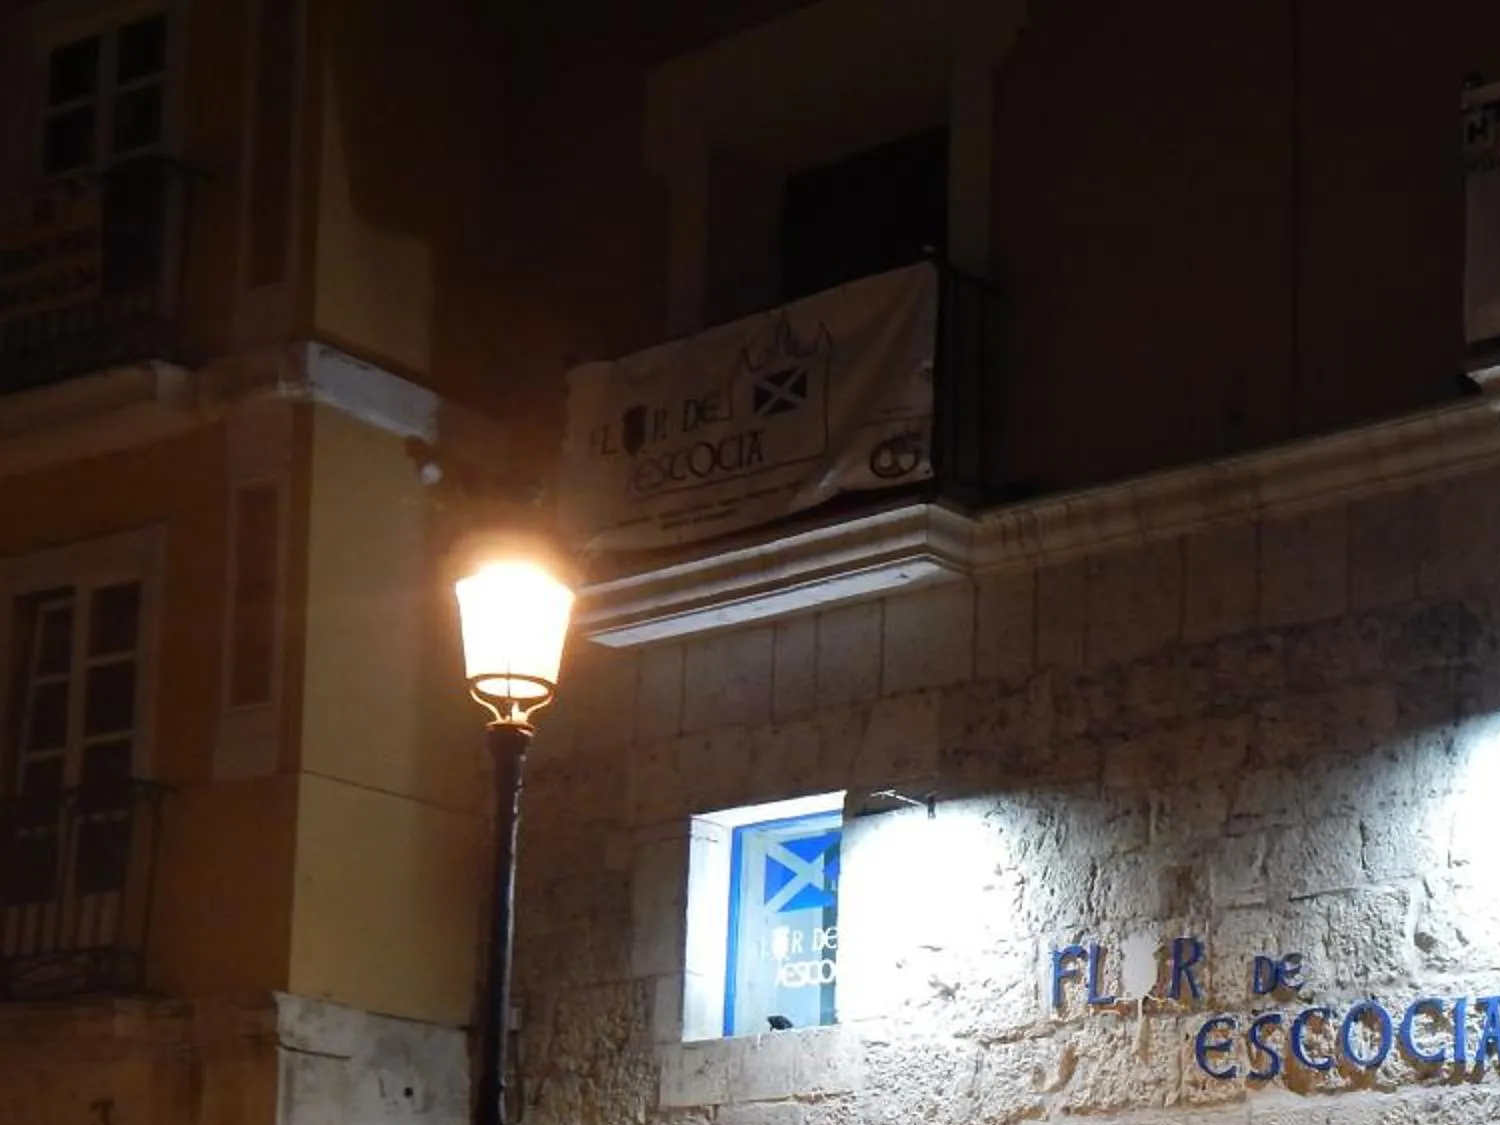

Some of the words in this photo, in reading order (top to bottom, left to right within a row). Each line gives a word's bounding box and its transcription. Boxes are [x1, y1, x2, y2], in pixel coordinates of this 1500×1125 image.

[632, 429, 764, 493] ESCOCIA
[782, 960, 838, 988] ESCO
[1253, 951, 1302, 995] DE
